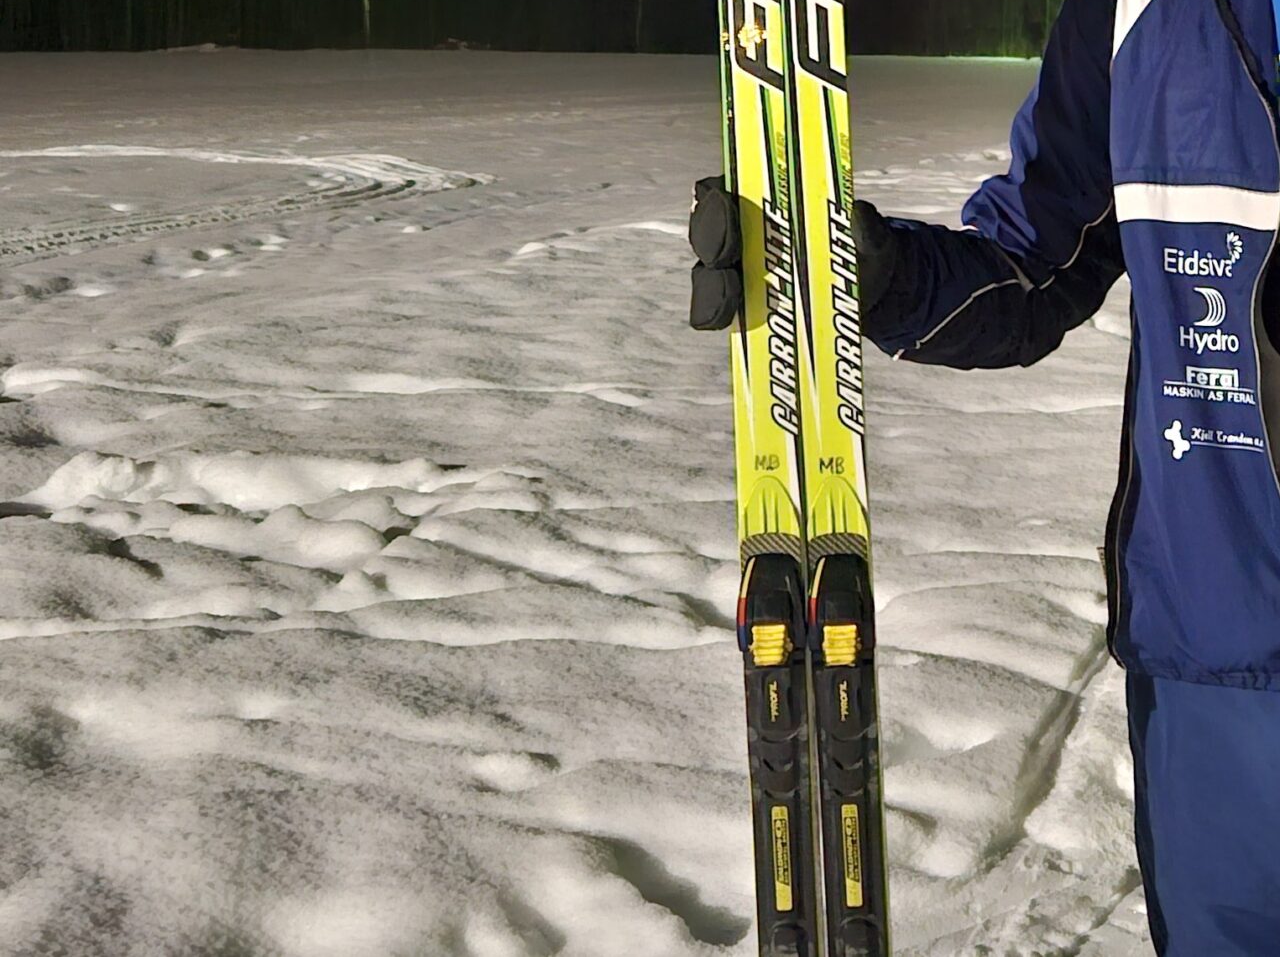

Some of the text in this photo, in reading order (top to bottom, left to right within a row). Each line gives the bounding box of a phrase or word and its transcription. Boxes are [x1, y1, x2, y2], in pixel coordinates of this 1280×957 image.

[1163, 247, 1233, 278] Eidsiva
[1179, 326, 1240, 355] Hydro
[1185, 365, 1240, 389] Feral
[1163, 385, 1256, 405] MASKIN AS FERAL
[819, 456, 845, 474] MB
